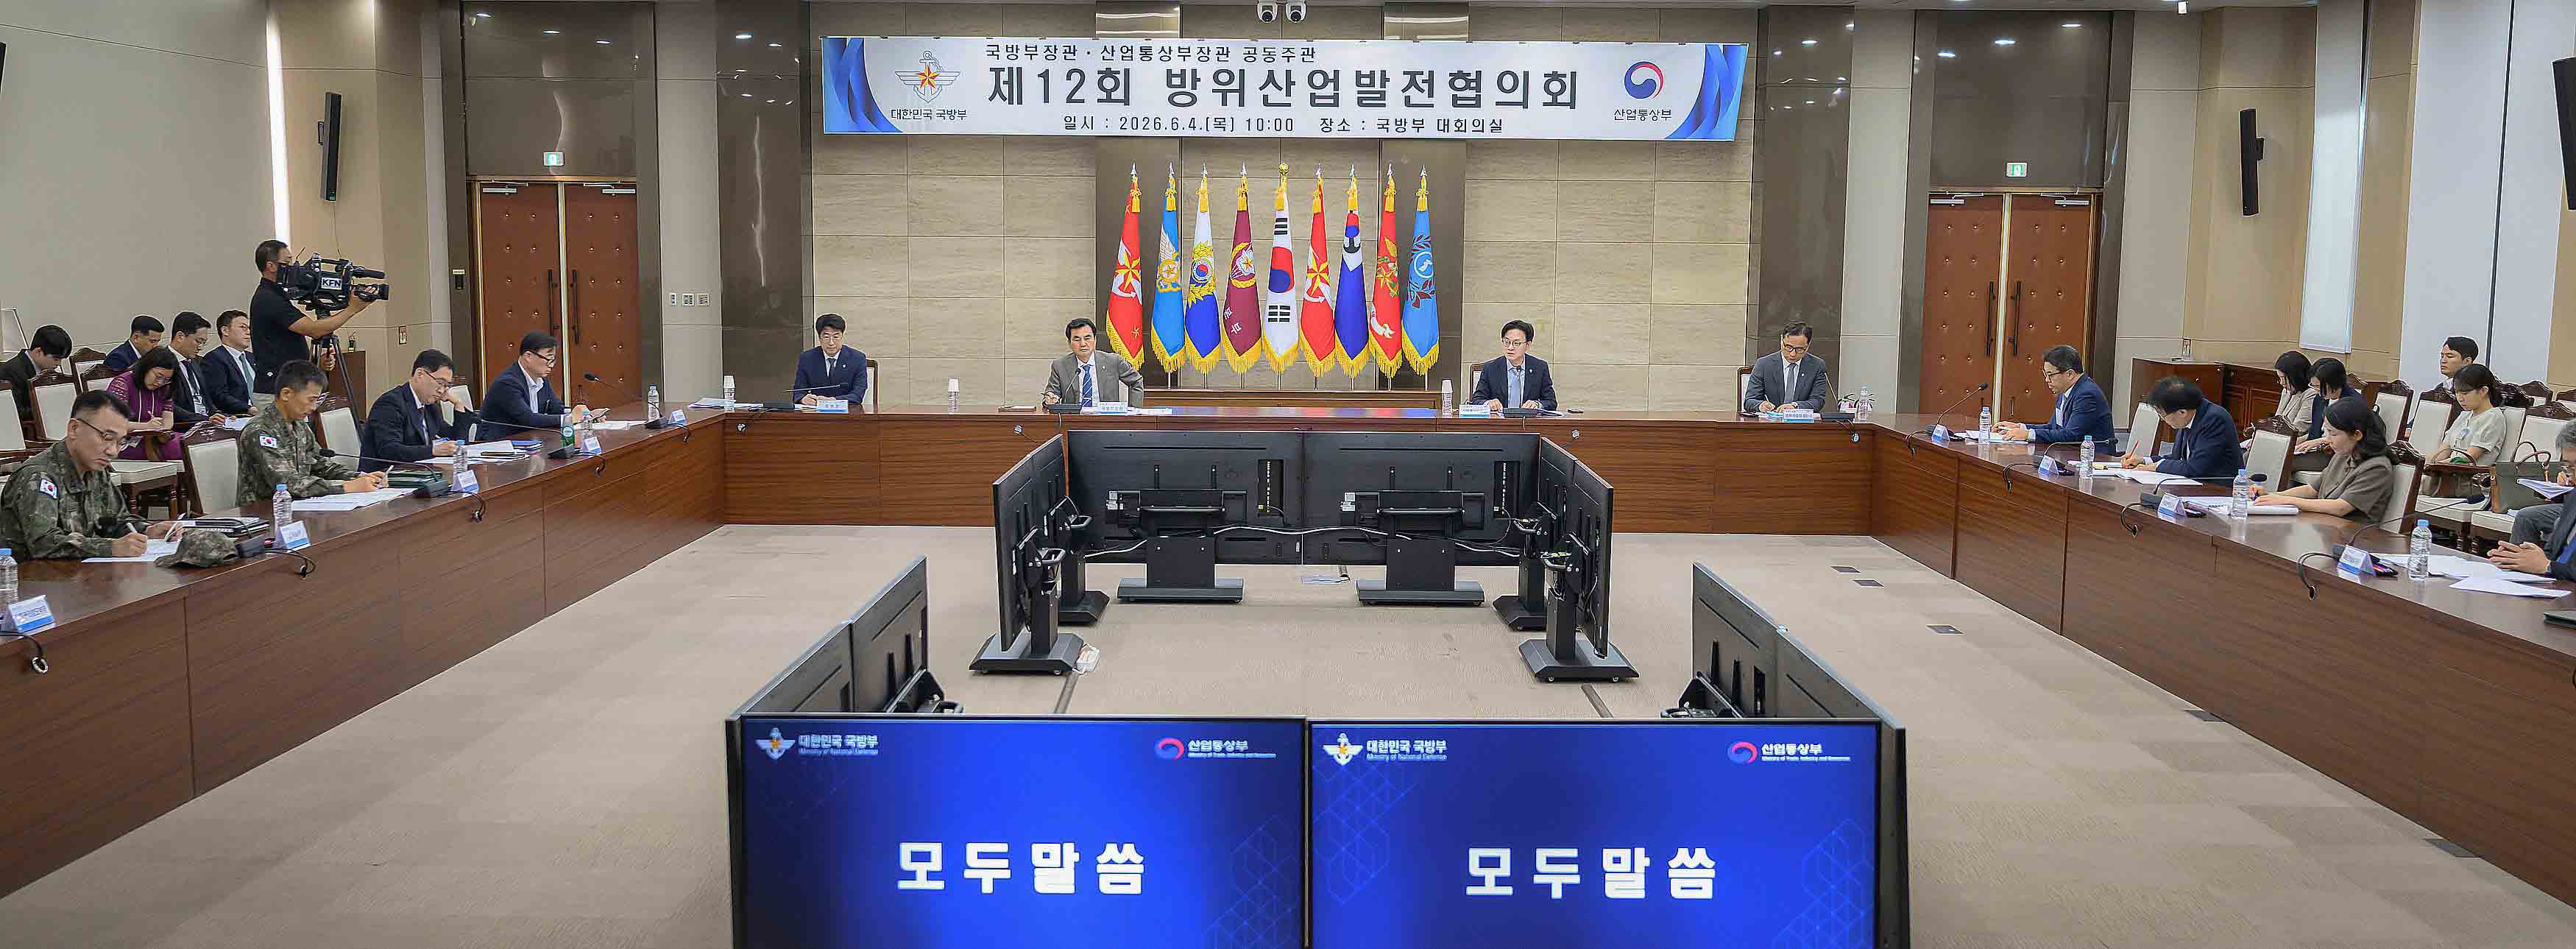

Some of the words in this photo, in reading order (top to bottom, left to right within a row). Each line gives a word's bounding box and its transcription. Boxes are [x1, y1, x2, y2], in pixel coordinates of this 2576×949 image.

[985, 44, 1078, 62] 국방부장관
[1100, 45, 1231, 63] 산업통상부장관
[1242, 46, 1317, 64] 공동주관
[987, 66, 1131, 107] 제12회
[1165, 68, 1578, 110] 방위산업발전협의회
[891, 108, 933, 121] 대한민국
[935, 108, 968, 121] 국방부
[1613, 108, 1673, 122] 산업통상부
[1063, 115, 1094, 131] 일시
[1245, 117, 1294, 133] 10:00
[1319, 117, 1351, 134] 장소
[1376, 118, 1426, 134] 국방부
[1436, 118, 1503, 134] 대회의실
[322, 279, 342, 287] KFN
[799, 735, 842, 748] 대한민국
[843, 735, 879, 749] 국방부
[1188, 740, 1249, 752] 산업통상부
[1366, 740, 1411, 754] 대한민국
[1413, 740, 1447, 754] 국방부
[1761, 743, 1822, 755] 산업통상부
